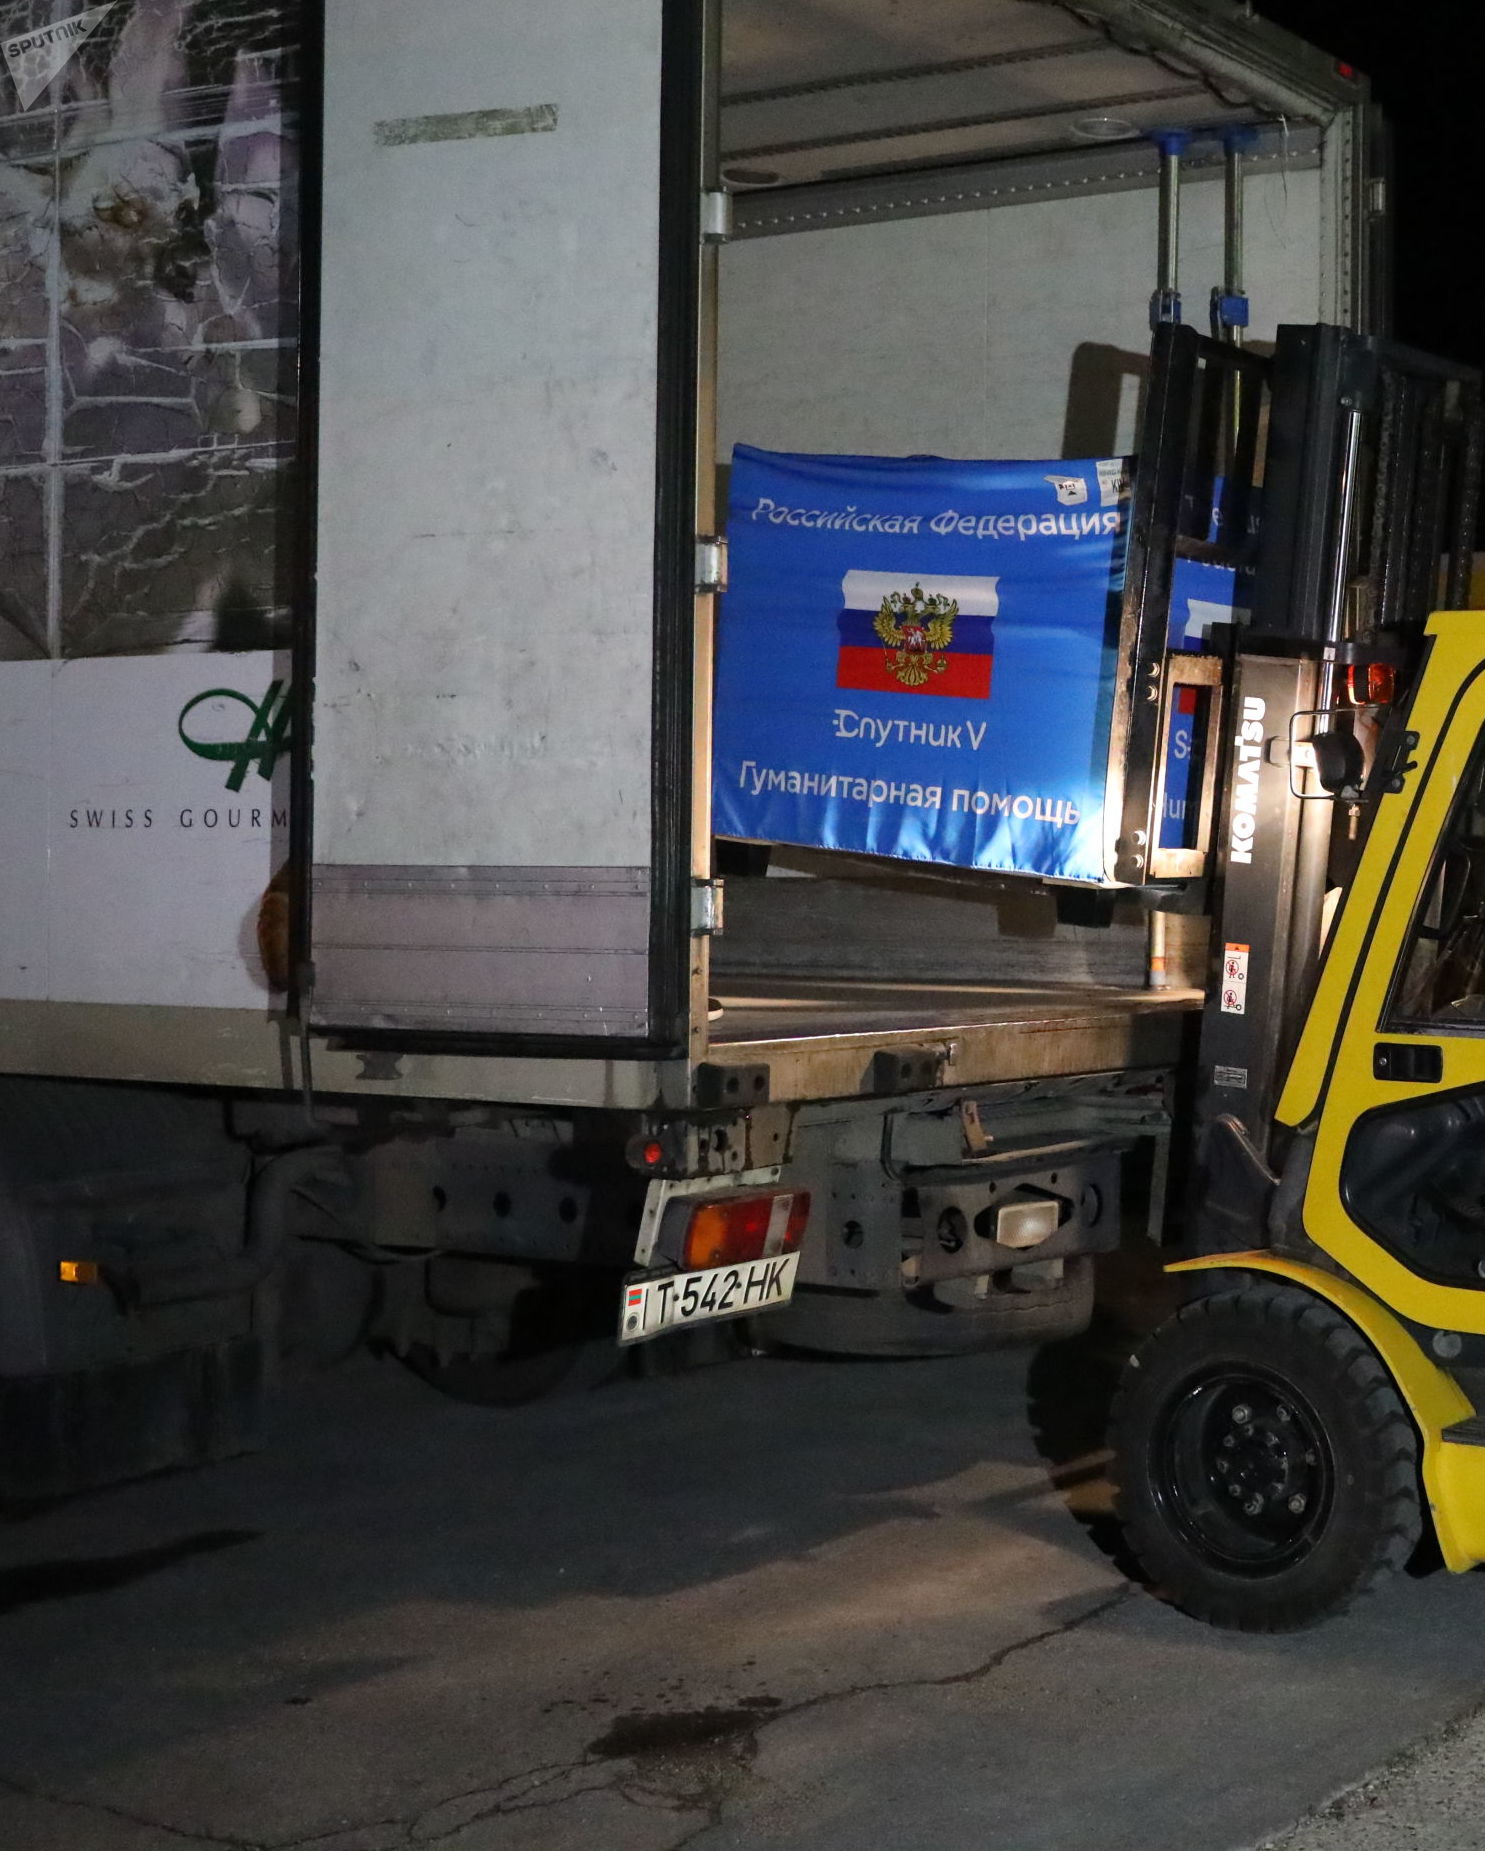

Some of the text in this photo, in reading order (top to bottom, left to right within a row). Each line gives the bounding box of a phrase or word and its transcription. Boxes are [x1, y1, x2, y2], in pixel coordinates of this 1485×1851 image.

[751, 498, 1121, 541] Российская Федерация
[831, 708, 987, 751] Спутник V
[738, 760, 1081, 830] Гуманитарная помощь
[1230, 696, 1266, 864] KOMATSU
[69, 808, 287, 829] SWISS GOURM
